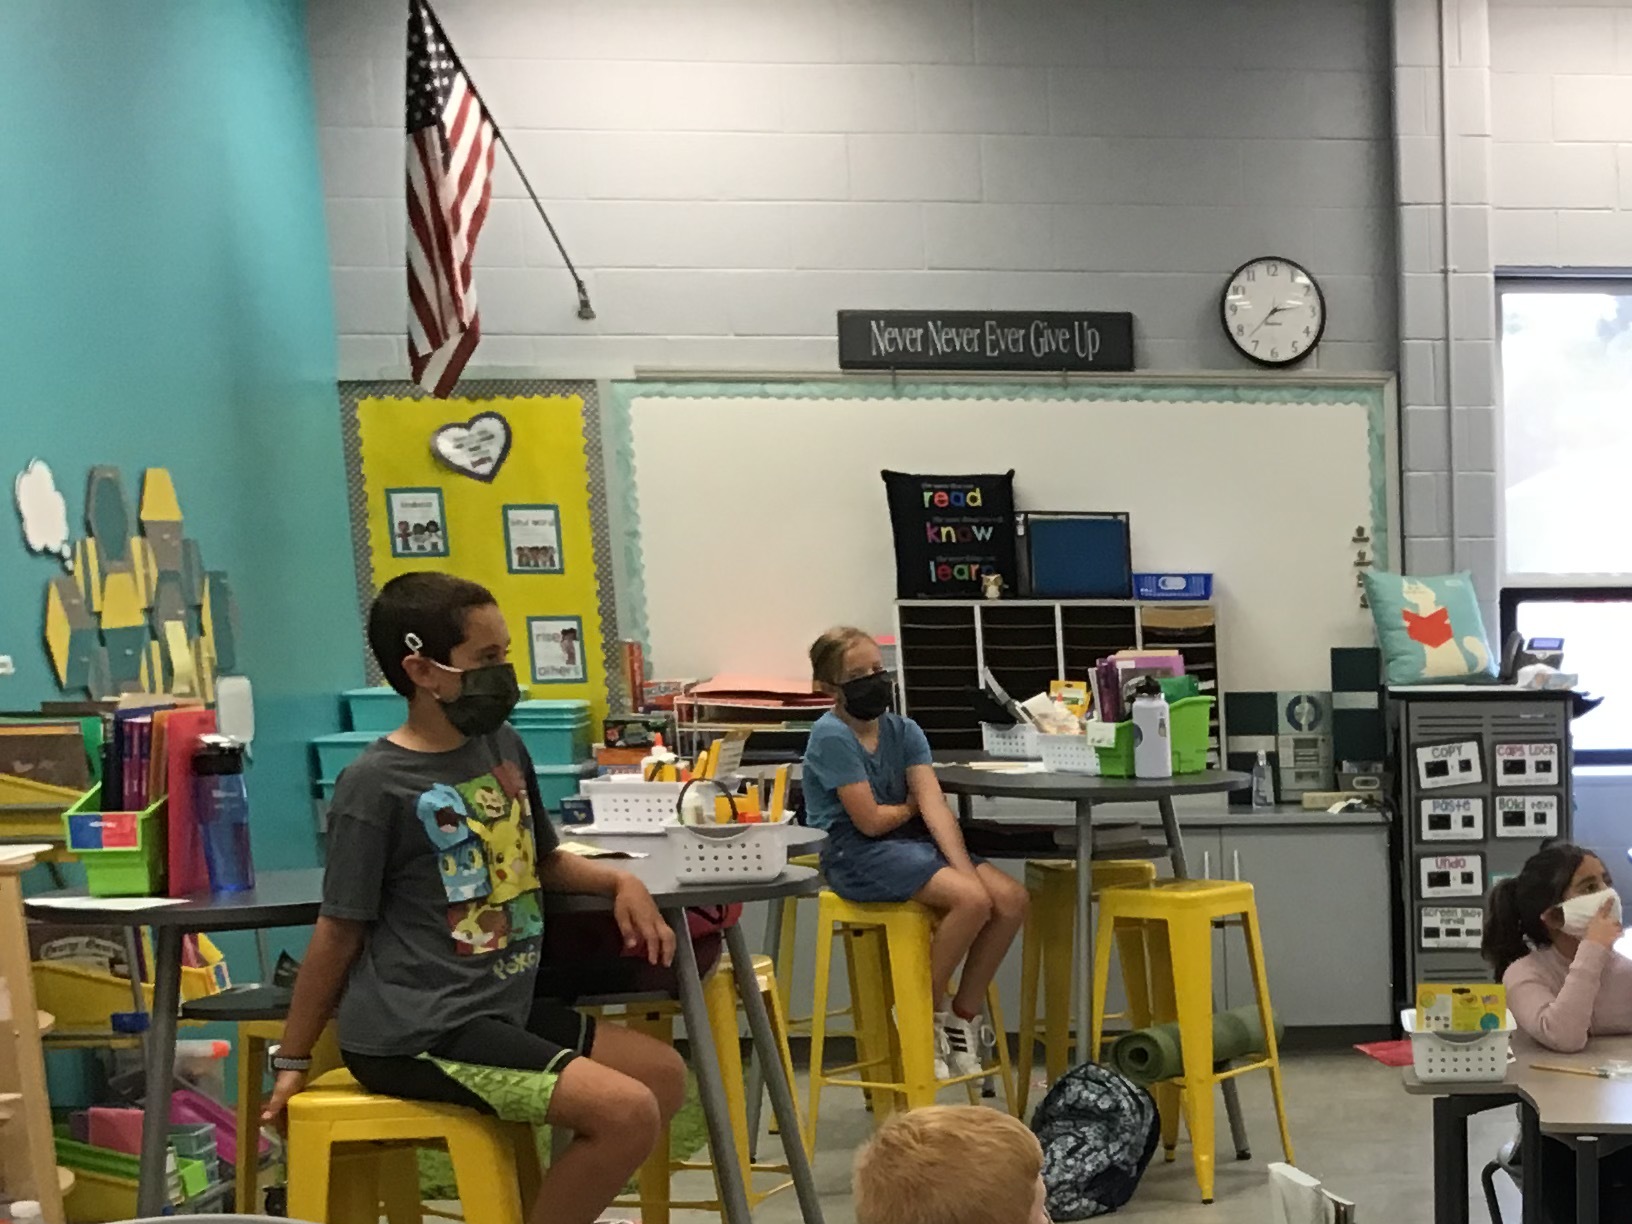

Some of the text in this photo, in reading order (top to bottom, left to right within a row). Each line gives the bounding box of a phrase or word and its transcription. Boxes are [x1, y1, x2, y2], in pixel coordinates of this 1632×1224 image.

[1266, 263, 1279, 277] 12
[1229, 303, 1238, 316] 9
[1309, 304, 1317, 319] 3
[1236, 323, 1245, 337] 8
[1302, 325, 1311, 338] 4
[870, 320, 1100, 361] Never Never Ever Give Up
[1251, 340, 1259, 352] 7
[1291, 340, 1299, 353] 5
[1270, 347, 1279, 359] 6
[923, 487, 982, 508] read
[925, 521, 993, 543] know
